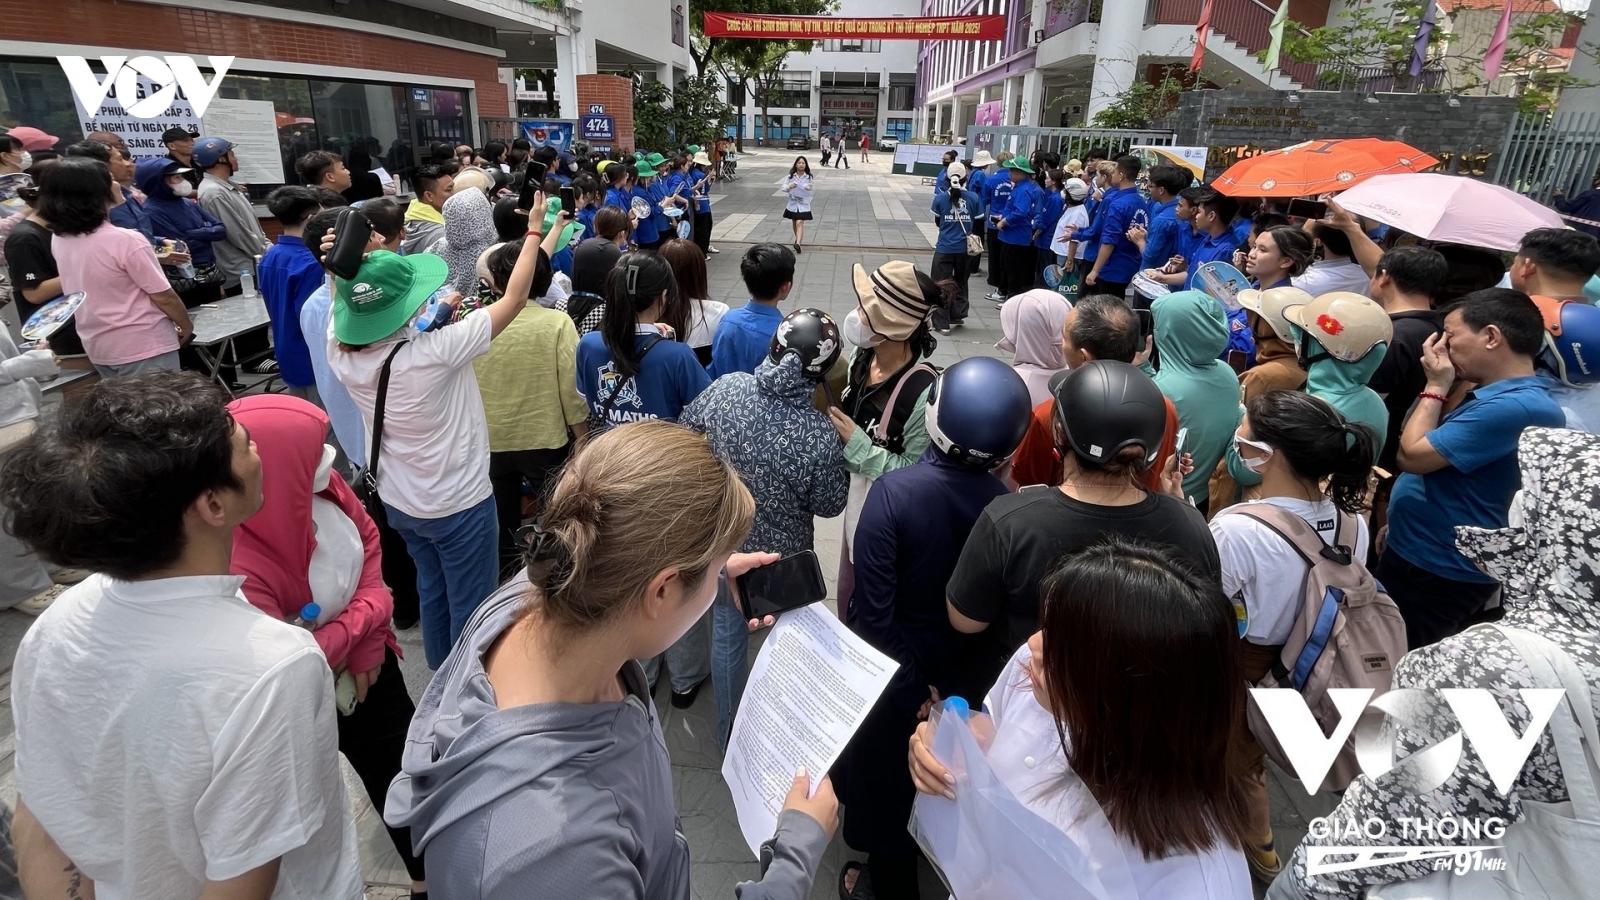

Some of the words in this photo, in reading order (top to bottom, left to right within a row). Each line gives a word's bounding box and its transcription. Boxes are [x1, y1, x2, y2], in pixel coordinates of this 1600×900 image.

[726, 18, 740, 31] CHÚC
[742, 18, 752, 31] CÁC
[857, 22, 868, 33] CAO
[869, 22, 886, 33] TRONG
[905, 19, 914, 33] TỐT
[936, 22, 950, 33] THPT
[185, 108, 191, 117] 3
[590, 105, 603, 113] 474
[188, 124, 199, 132] 26
[586, 119, 609, 131] 474
